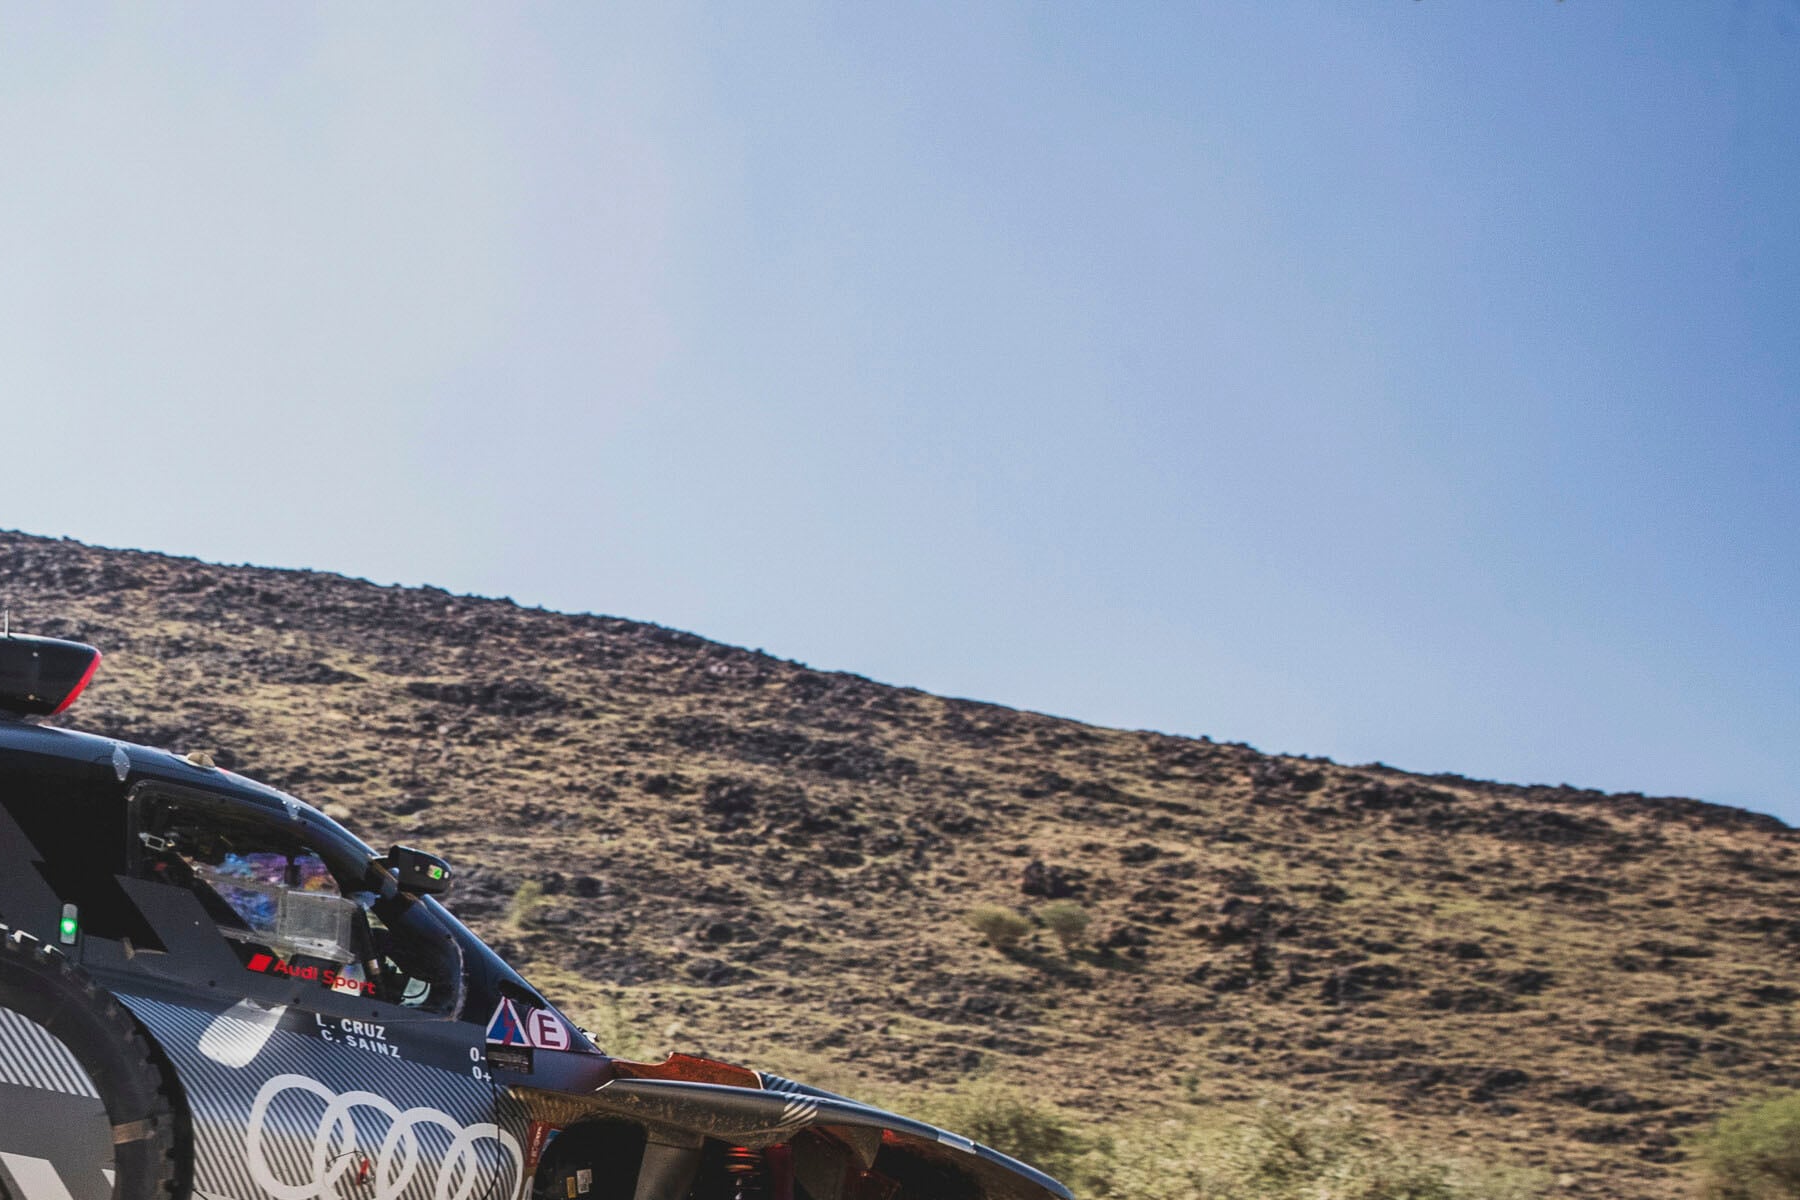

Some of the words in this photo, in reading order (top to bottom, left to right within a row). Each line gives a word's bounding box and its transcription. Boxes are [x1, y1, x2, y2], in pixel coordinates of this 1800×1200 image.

[273, 959, 318, 980] Audi
[322, 969, 377, 995] Sport
[341, 1018, 387, 1040] CRUZ
[537, 1013, 561, 1047] E
[347, 1035, 401, 1058] SAINZ
